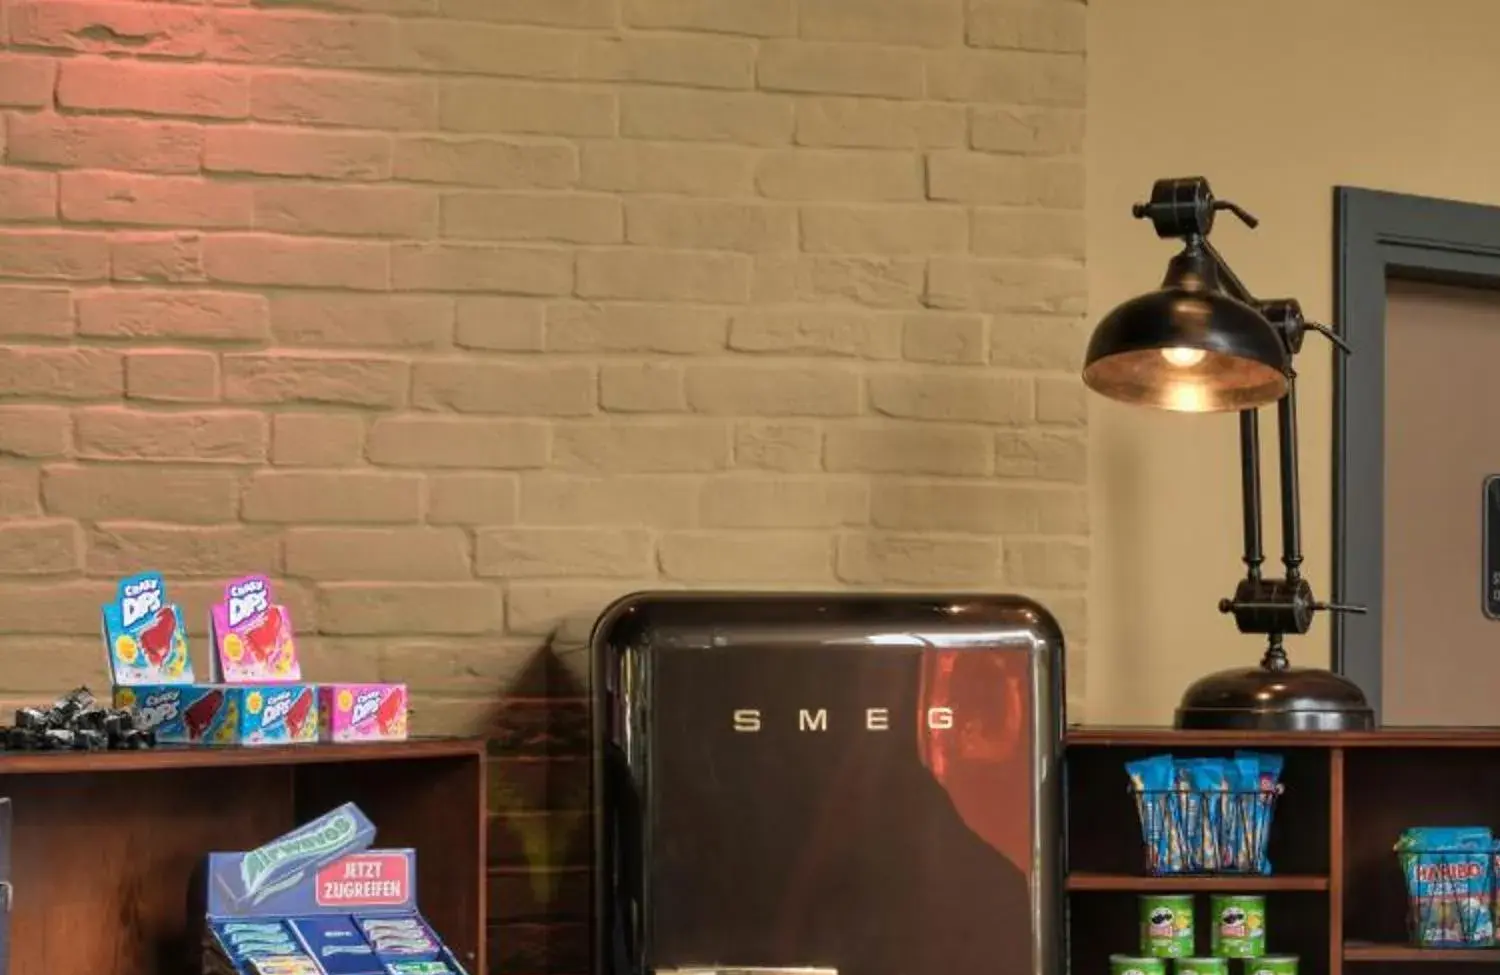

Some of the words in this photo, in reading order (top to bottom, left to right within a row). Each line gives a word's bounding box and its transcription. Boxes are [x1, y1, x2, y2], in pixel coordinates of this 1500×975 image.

[122, 589, 162, 628] DIPS
[228, 590, 269, 628] DIPS
[733, 707, 954, 732] SMEG
[343, 862, 383, 878] JETZT
[323, 880, 402, 899] ZUGREIFEN
